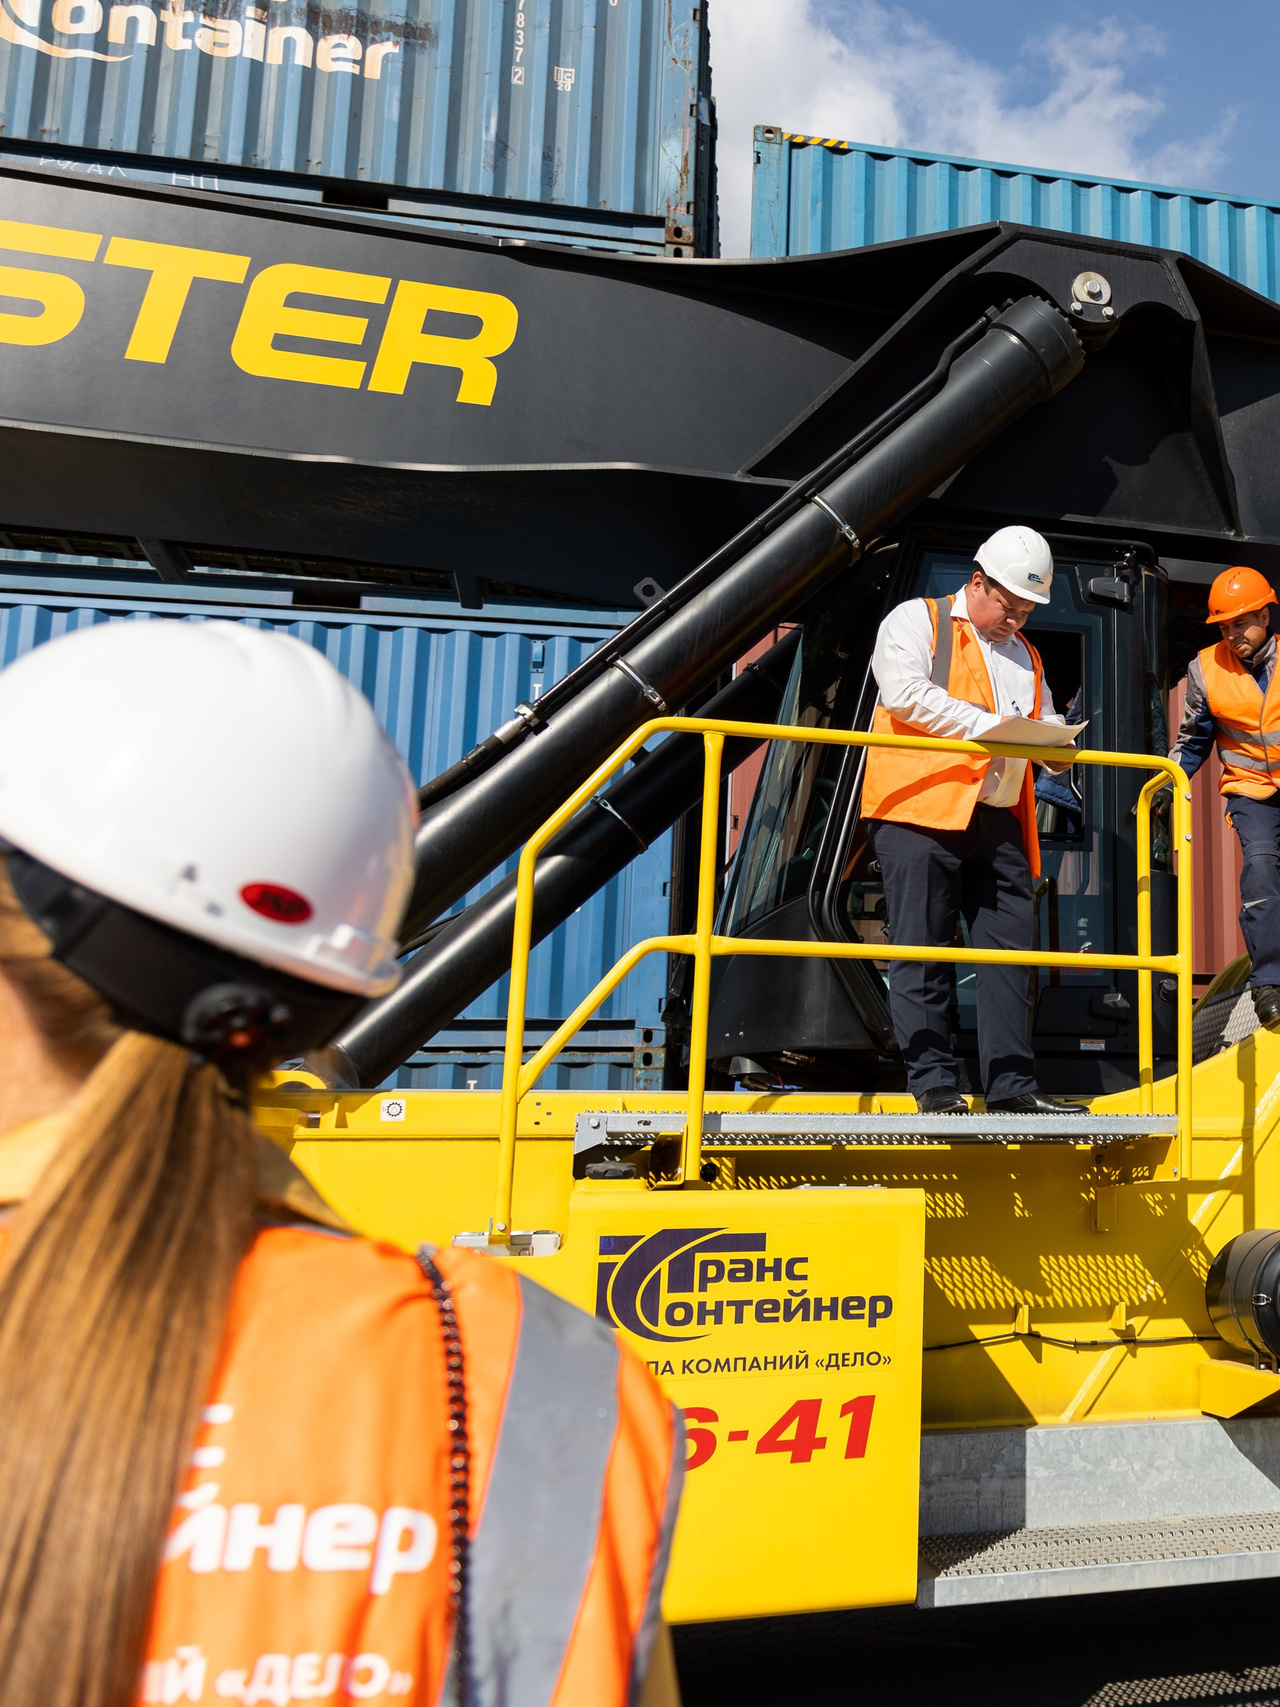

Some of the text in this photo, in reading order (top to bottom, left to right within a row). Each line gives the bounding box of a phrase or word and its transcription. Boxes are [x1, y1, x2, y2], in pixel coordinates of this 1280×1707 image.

[646, 1350, 892, 1376] ПА КОМПАНИЙ «ДЕЛО»
